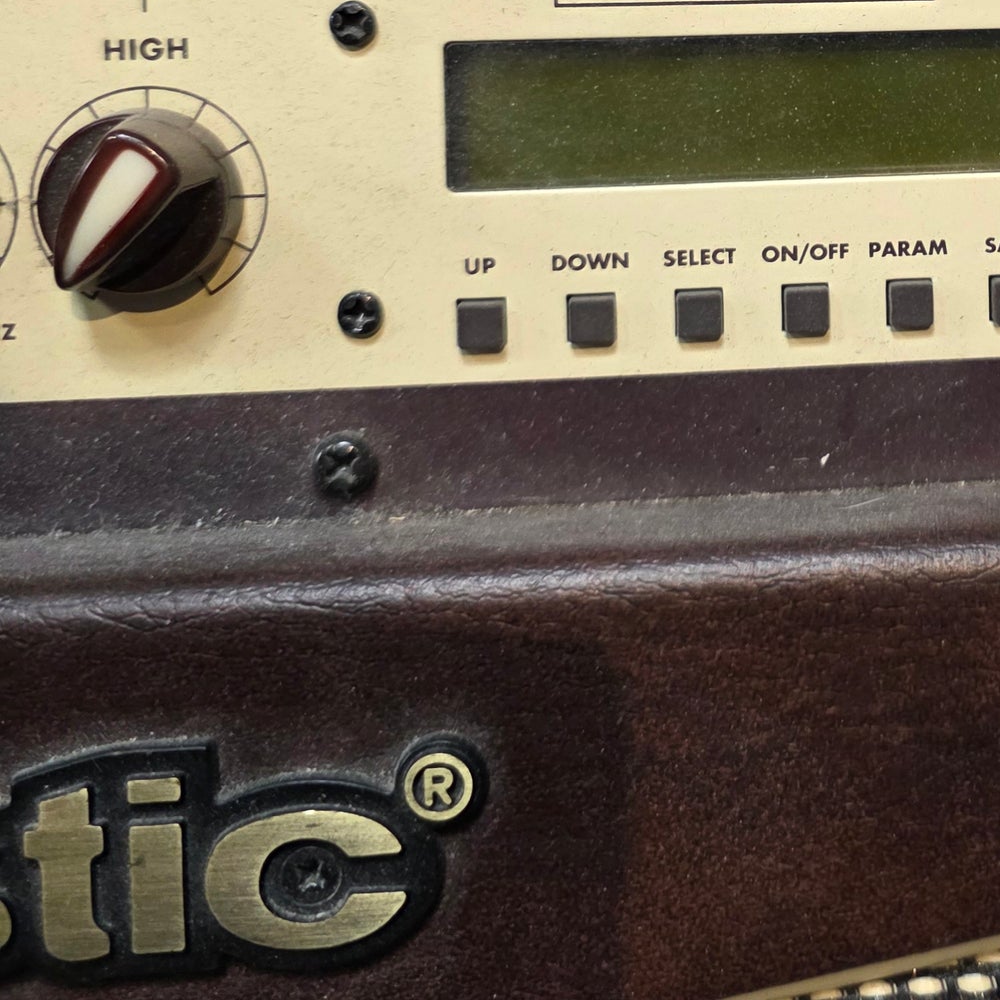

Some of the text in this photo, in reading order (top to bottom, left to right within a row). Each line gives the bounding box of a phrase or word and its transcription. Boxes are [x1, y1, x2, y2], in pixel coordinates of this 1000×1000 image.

[103, 38, 190, 61] HIGH
[663, 248, 736, 268] SELECT
[761, 243, 850, 265] ON/OFF
[868, 239, 948, 259] PARAM
[464, 257, 496, 276] UP
[552, 252, 630, 272] DOWN
